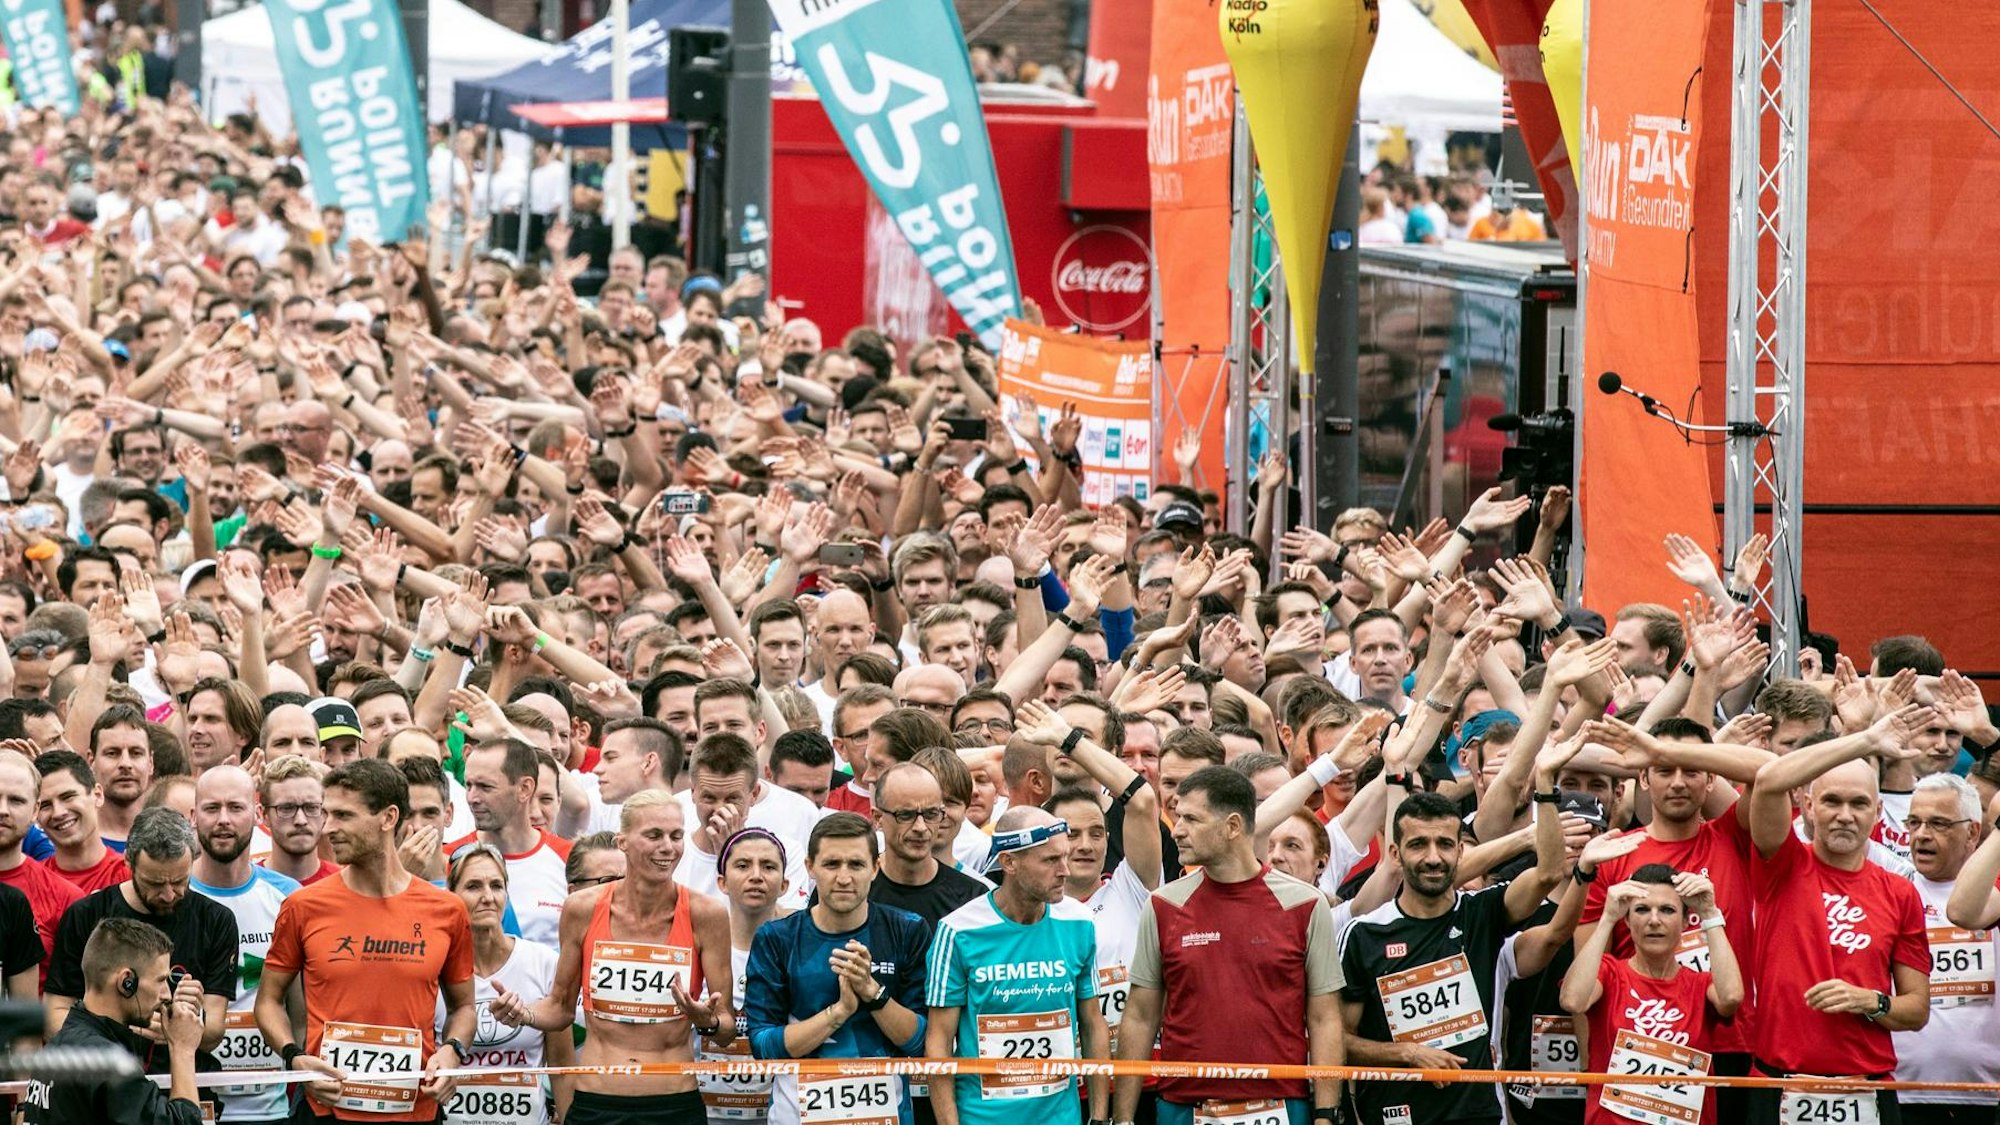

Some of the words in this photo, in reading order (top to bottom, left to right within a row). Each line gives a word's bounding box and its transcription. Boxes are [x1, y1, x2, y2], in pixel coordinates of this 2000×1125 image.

[1229, 18, 1261, 34] Köln
[1629, 115, 1692, 190] DAK
[1626, 185, 1691, 233] Gesundheit
[1822, 892, 1867, 922] The
[362, 936, 426, 956] bunert
[1389, 946, 1405, 955] DB
[975, 960, 1066, 983] SIEMENS
[993, 983, 1044, 1002] Ingenuity
[1046, 982, 1063, 996] for
[1401, 981, 1461, 1019] 5847
[1625, 988, 1685, 1021] The
[1472, 1014, 1479, 1023] B
[460, 1051, 528, 1066] OYOTA
[1003, 1037, 1052, 1059] 223
[329, 1047, 412, 1073] 14734
[402, 1090, 410, 1099] B
[448, 1092, 531, 1116] 20885
[806, 1082, 889, 1110] 21545
[1685, 1110, 1693, 1119] B
[1797, 1099, 1860, 1122] 2451
